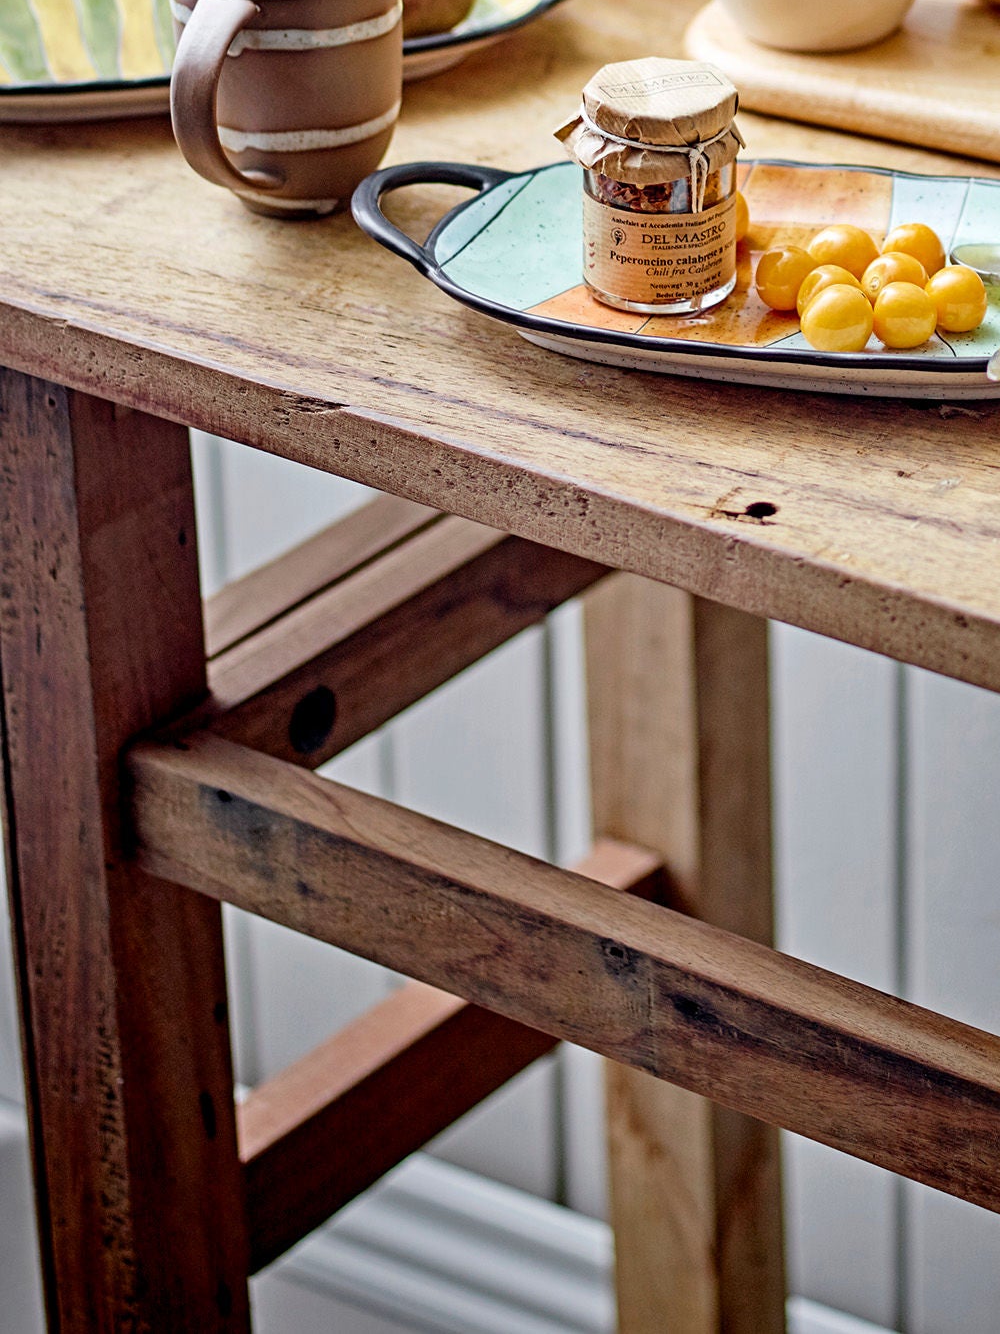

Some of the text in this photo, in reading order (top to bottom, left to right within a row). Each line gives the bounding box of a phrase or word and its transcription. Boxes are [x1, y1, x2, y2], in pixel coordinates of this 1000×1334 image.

[611, 217, 639, 227] Anbefalet
[642, 234, 670, 245] DEL
[674, 221, 726, 245] MASTRO
[610, 250, 673, 266] Peperoncino
[676, 249, 718, 265] calabrese
[645, 267, 669, 276] Chili
[670, 266, 685, 278] fra
